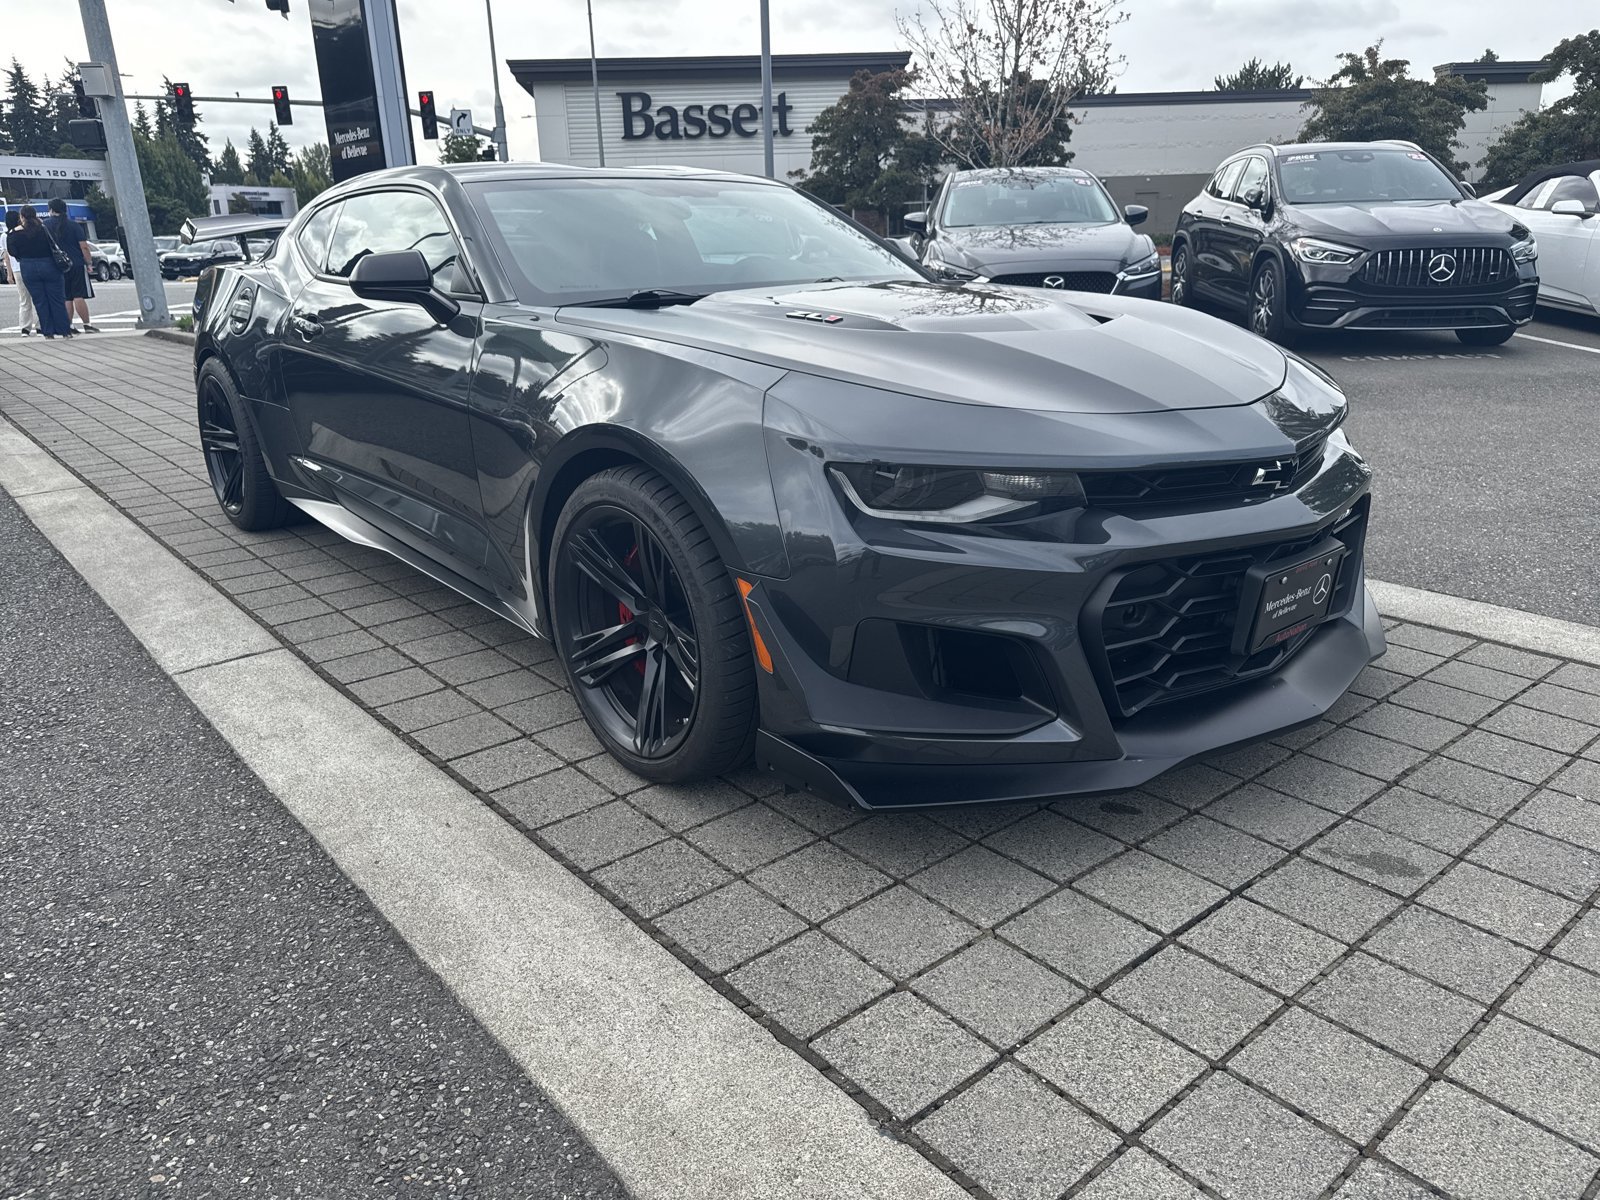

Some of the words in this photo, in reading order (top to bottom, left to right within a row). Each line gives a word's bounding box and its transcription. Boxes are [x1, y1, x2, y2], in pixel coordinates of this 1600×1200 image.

[616, 91, 794, 140] Basset
[334, 127, 370, 145] Mercedes-Benz
[347, 145, 368, 158] Bellevue
[10, 168, 41, 176] PARK
[46, 169, 67, 177] 120
[1264, 586, 1312, 613] Mercedes-Benz
[1278, 604, 1298, 617] Bellevue
